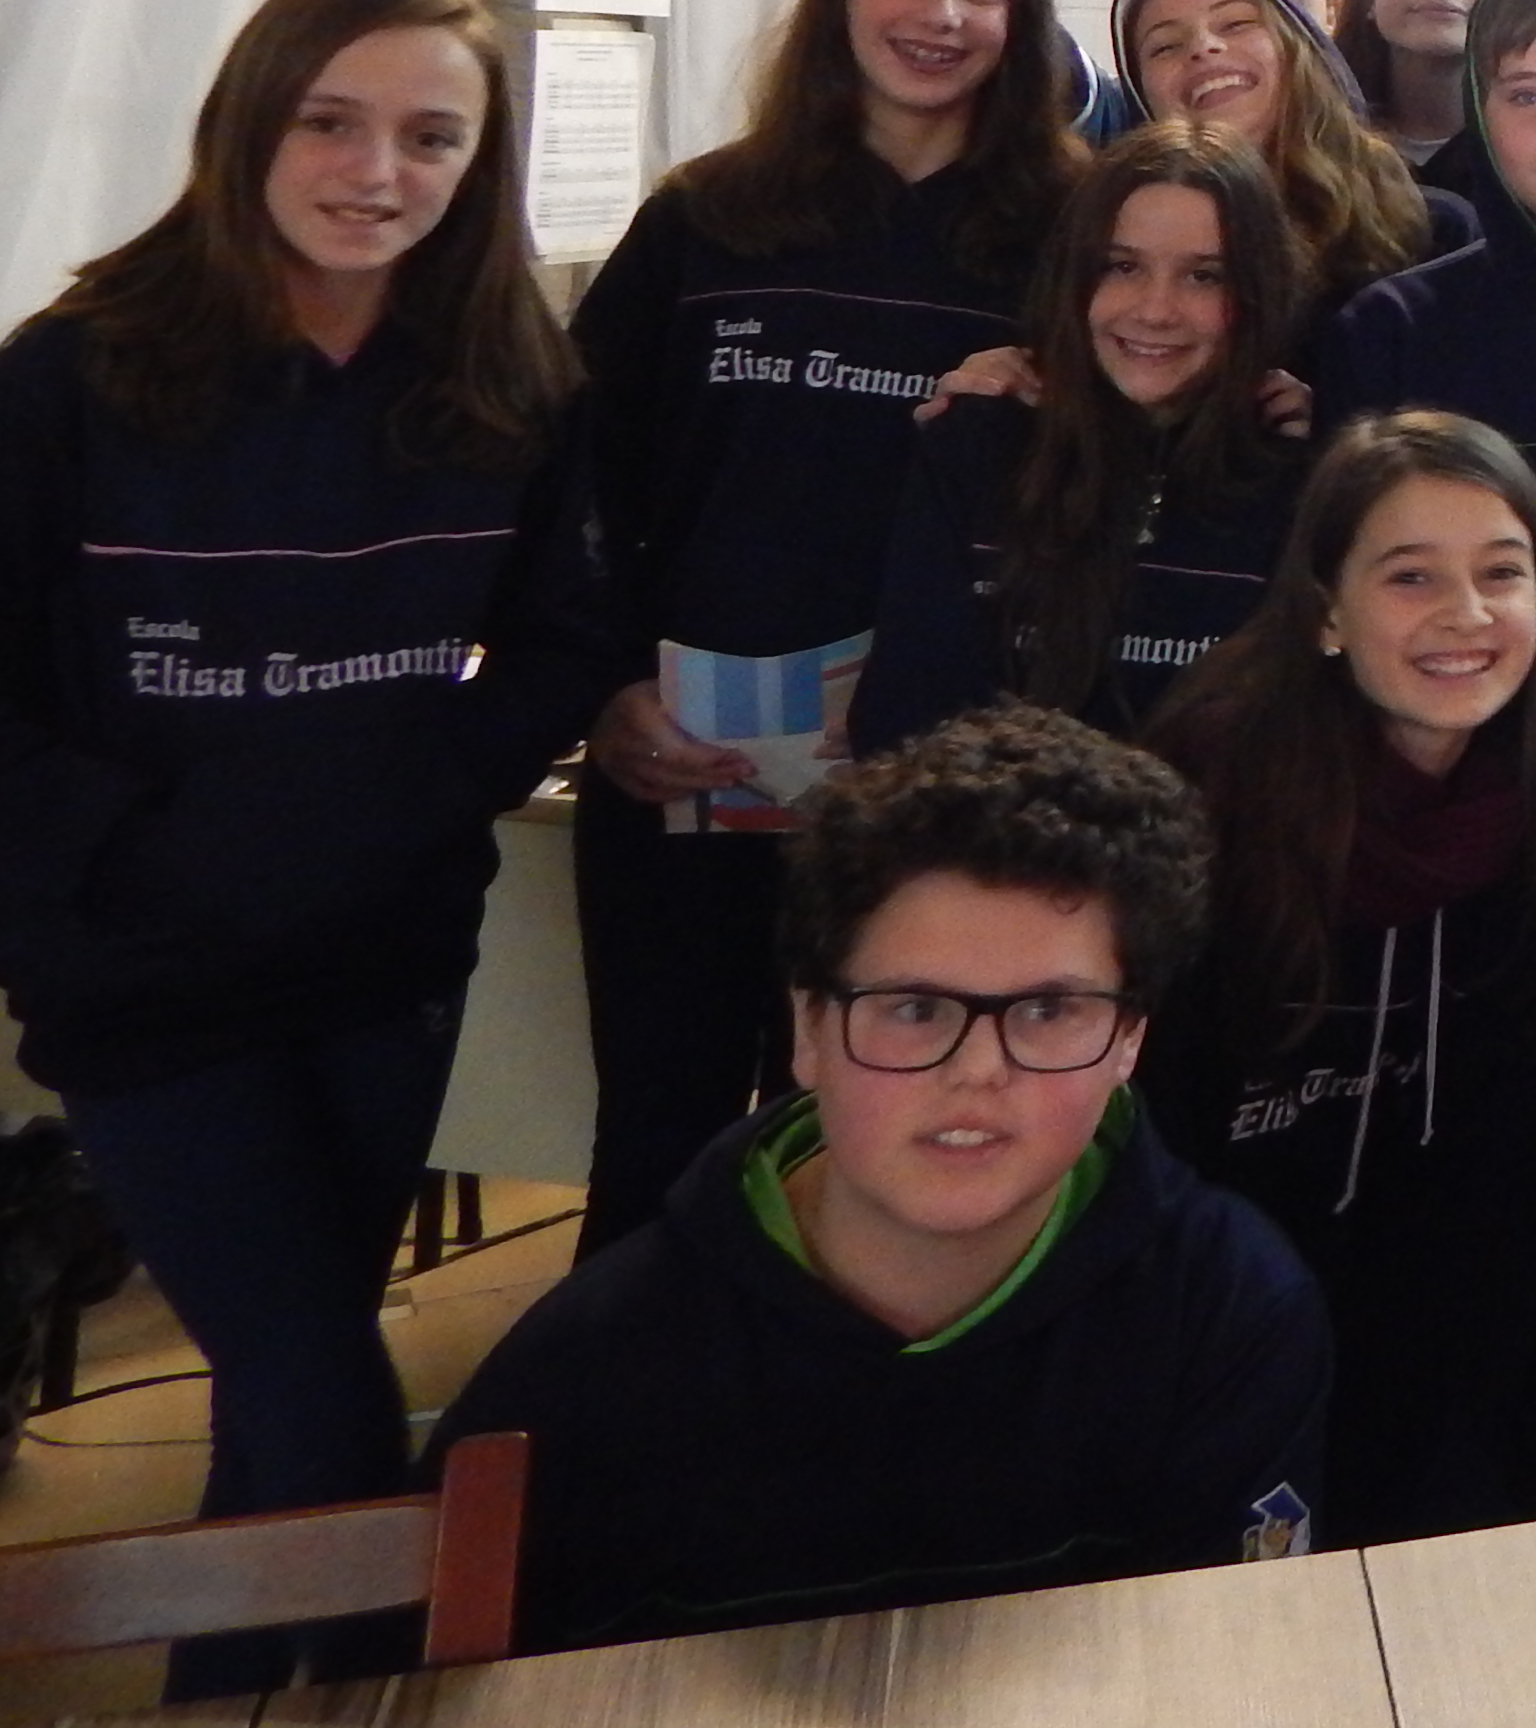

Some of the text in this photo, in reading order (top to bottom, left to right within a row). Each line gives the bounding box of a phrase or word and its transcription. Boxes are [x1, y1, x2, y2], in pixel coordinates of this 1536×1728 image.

[708, 346, 938, 400] Elisa Tramon
[129, 637, 474, 698] Elisa Tramonti
